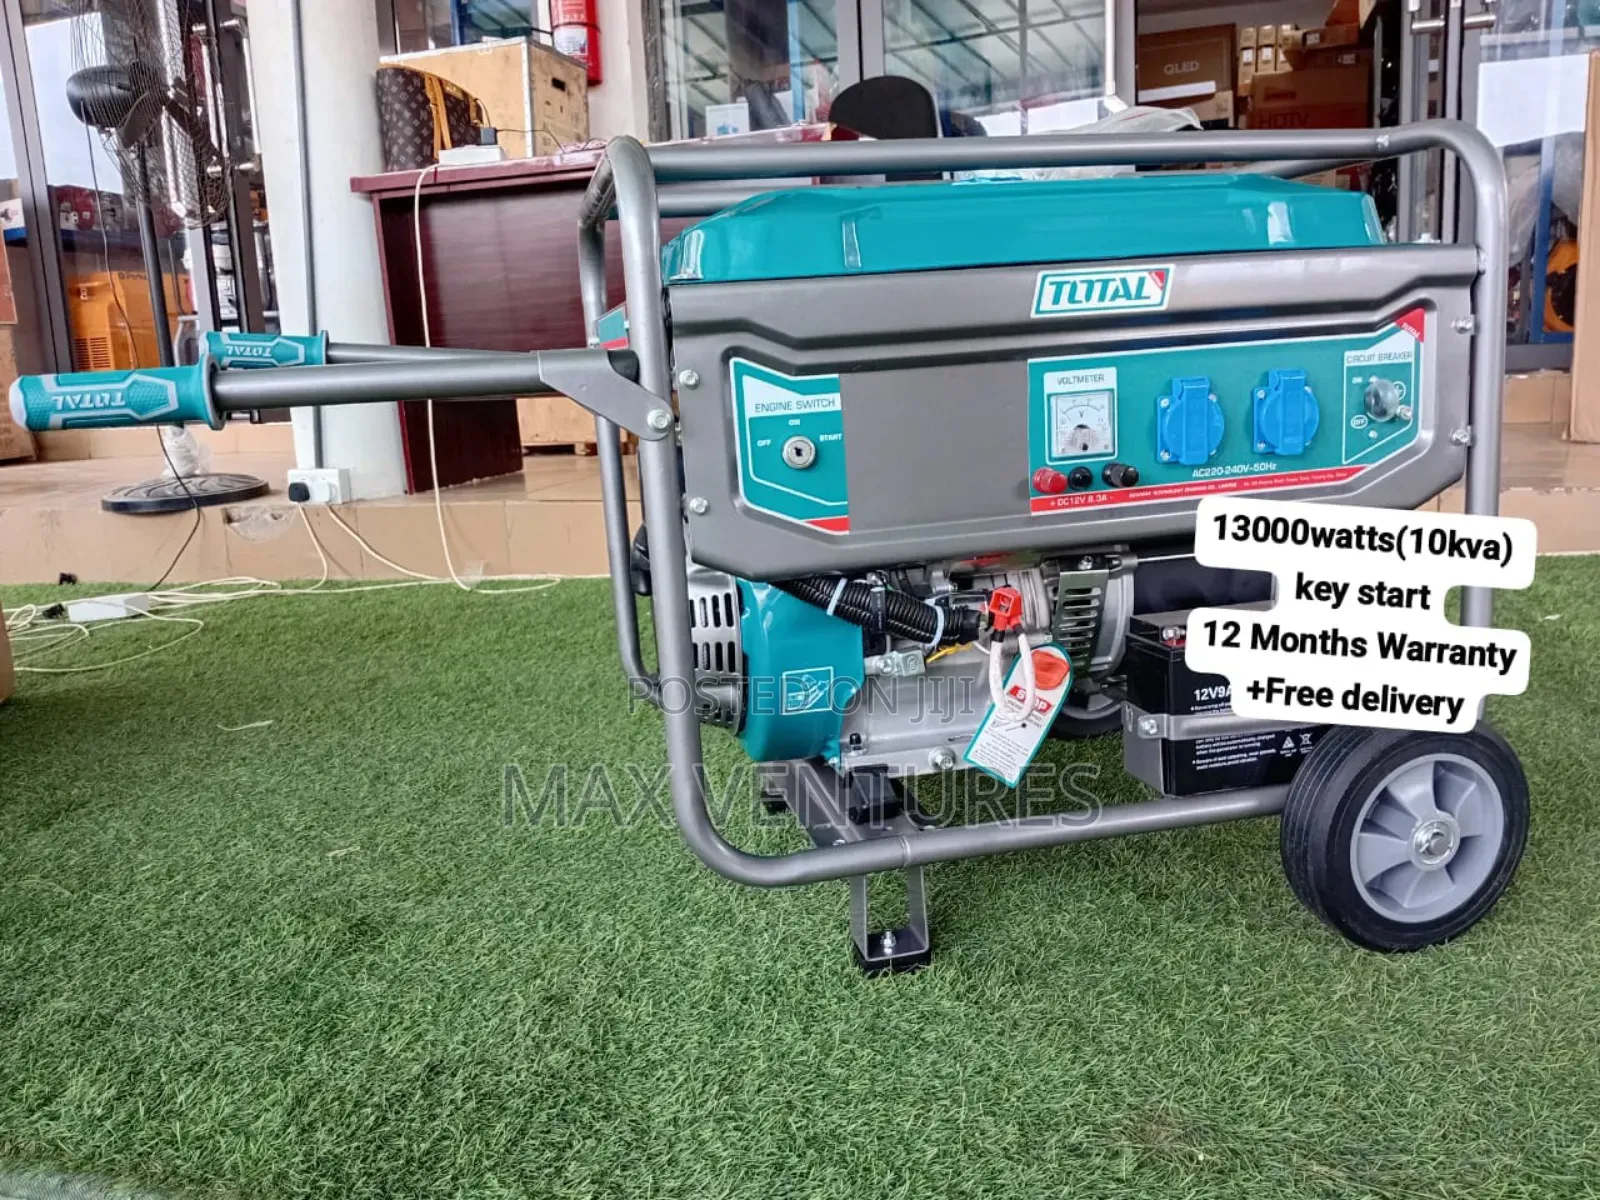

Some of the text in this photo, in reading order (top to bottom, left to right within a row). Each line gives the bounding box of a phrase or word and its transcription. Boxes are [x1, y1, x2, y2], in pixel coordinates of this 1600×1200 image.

[1163, 60, 1200, 75] QLED
[1049, 276, 1151, 306] TOTAL
[1347, 351, 1413, 364] CIRCUIT BREAKER
[1057, 373, 1105, 385] VOLTMETER
[52, 391, 126, 410] TOTAL
[755, 398, 836, 413] ENGINE SWITCH
[757, 439, 771, 447] OFF
[819, 433, 842, 442] START
